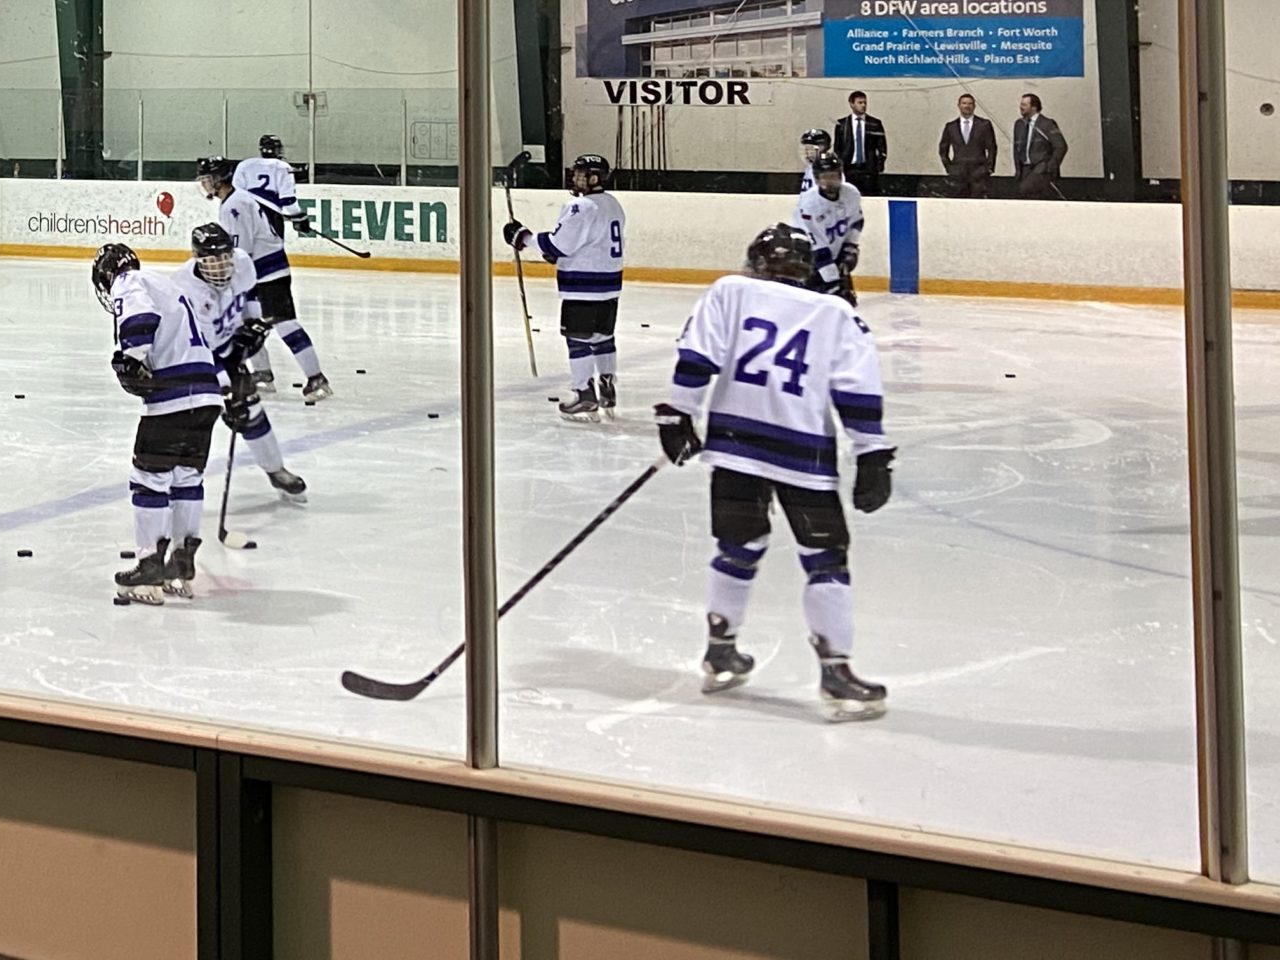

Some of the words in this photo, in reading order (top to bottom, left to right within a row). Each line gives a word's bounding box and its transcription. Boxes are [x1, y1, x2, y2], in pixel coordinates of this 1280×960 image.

[860, 1, 871, 16] 8
[875, 0, 917, 16] DFW
[920, 3, 959, 15] area
[846, 28, 889, 38] Alliance
[902, 27, 944, 38] Farmers
[946, 27, 984, 37] Branch
[997, 27, 1021, 37] Fort
[1022, 26, 1058, 37] Worth
[852, 41, 884, 51] Grand
[886, 41, 921, 51] Prairie
[934, 41, 987, 51] Lewisville
[1000, 41, 1053, 52] Mesquite
[864, 54, 896, 64] North
[897, 54, 943, 65] Richland
[945, 54, 970, 64] Hills
[983, 54, 1014, 64] Plano
[1017, 54, 1039, 64] East
[603, 80, 751, 105] VISITOR
[610, 220, 622, 258] 9
[734, 316, 811, 397] 24
